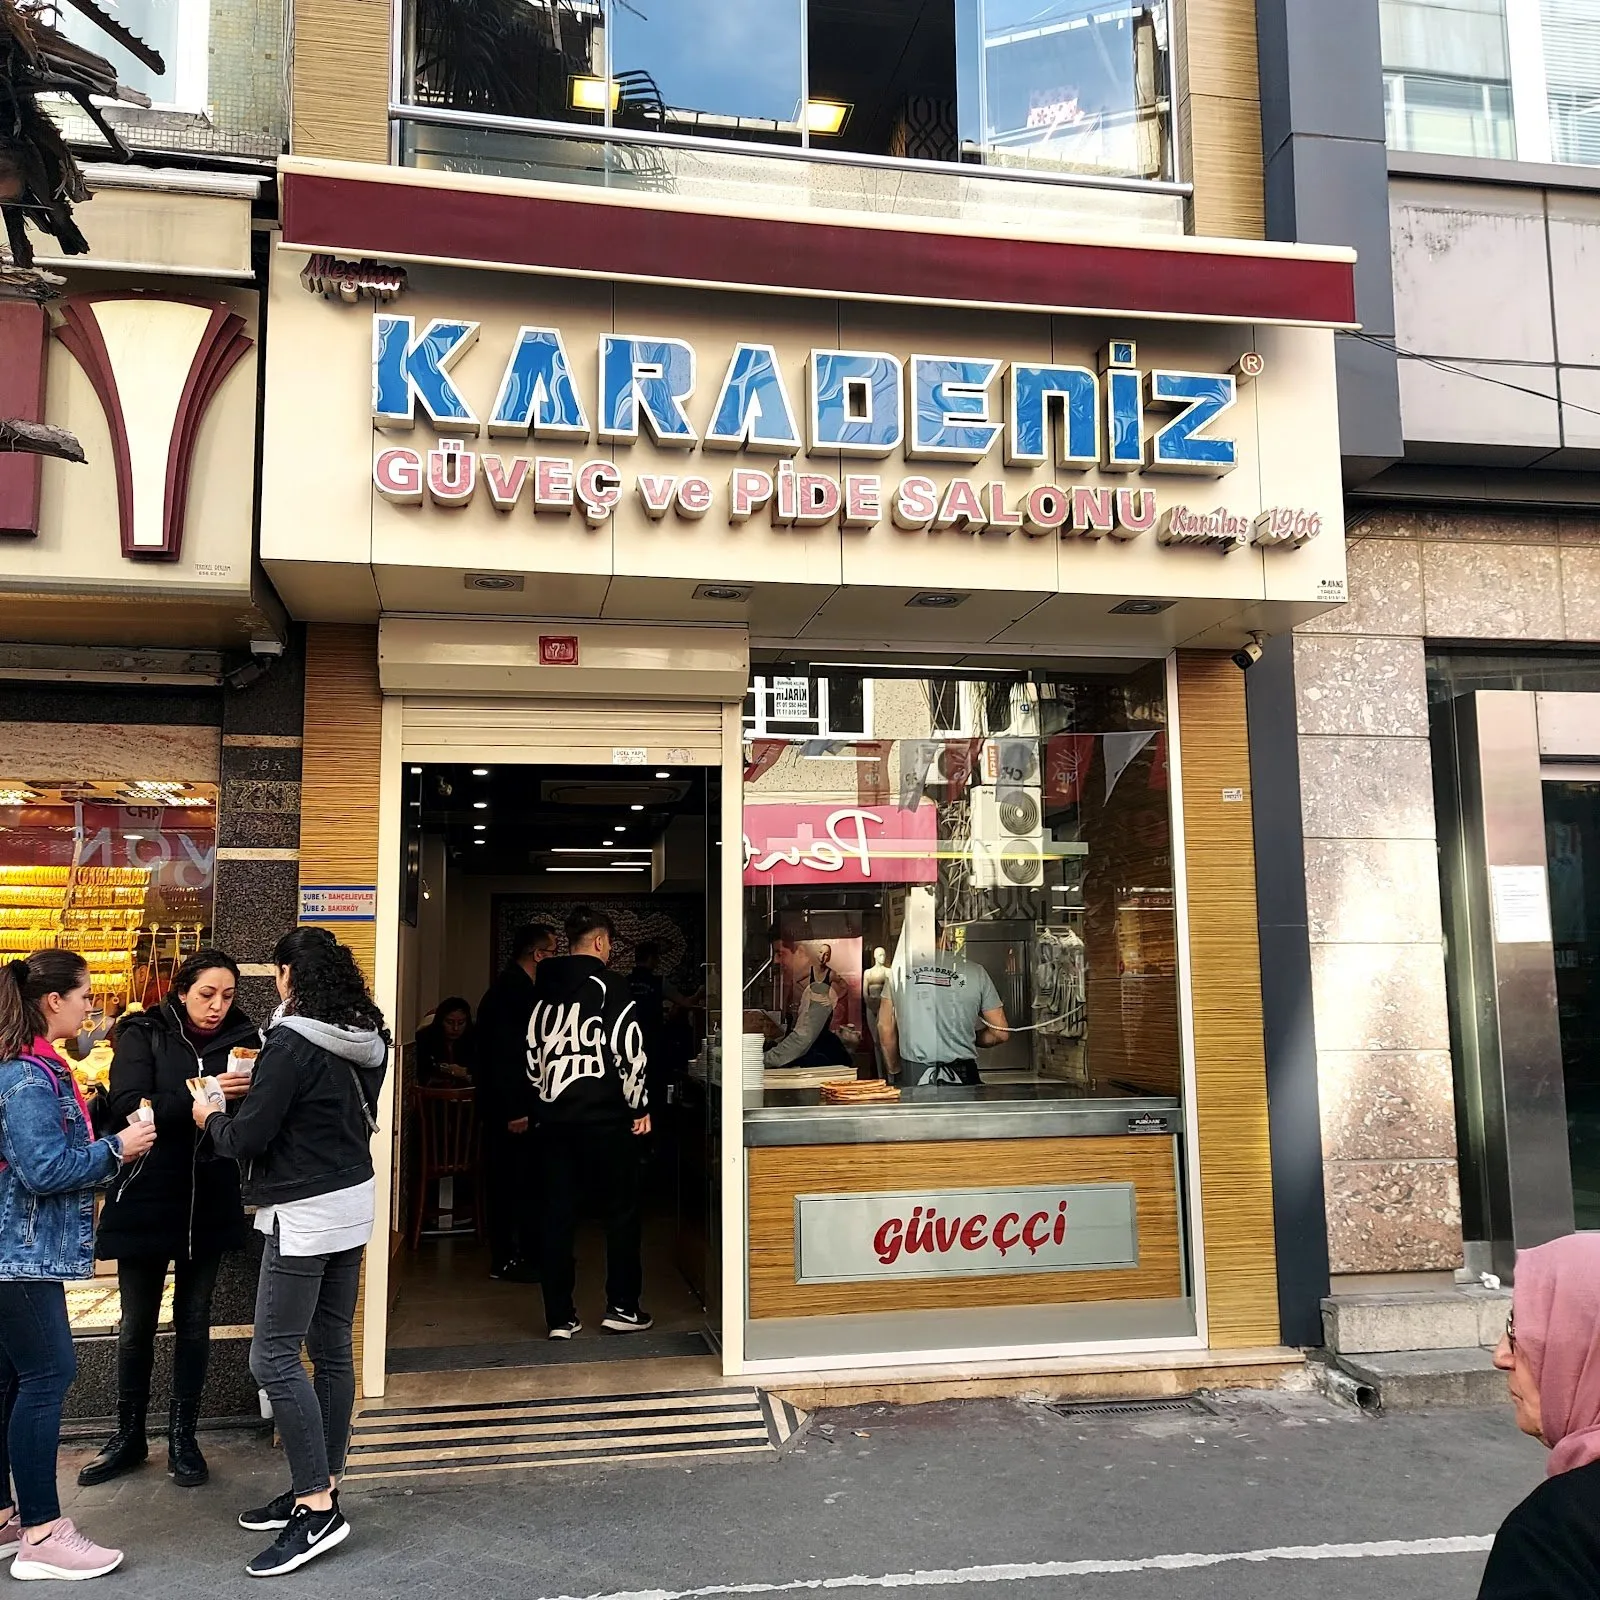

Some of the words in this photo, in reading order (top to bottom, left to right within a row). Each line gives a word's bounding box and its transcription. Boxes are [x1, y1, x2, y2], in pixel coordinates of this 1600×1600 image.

[373, 438, 624, 520] GÜVEÇ
[637, 474, 714, 513] ve
[732, 459, 882, 520] PİDE
[897, 474, 1158, 533] SALONU
[1170, 504, 1249, 544] Kuruluş
[1268, 506, 1323, 540] 1966
[303, 893, 320, 901] ŞUBE
